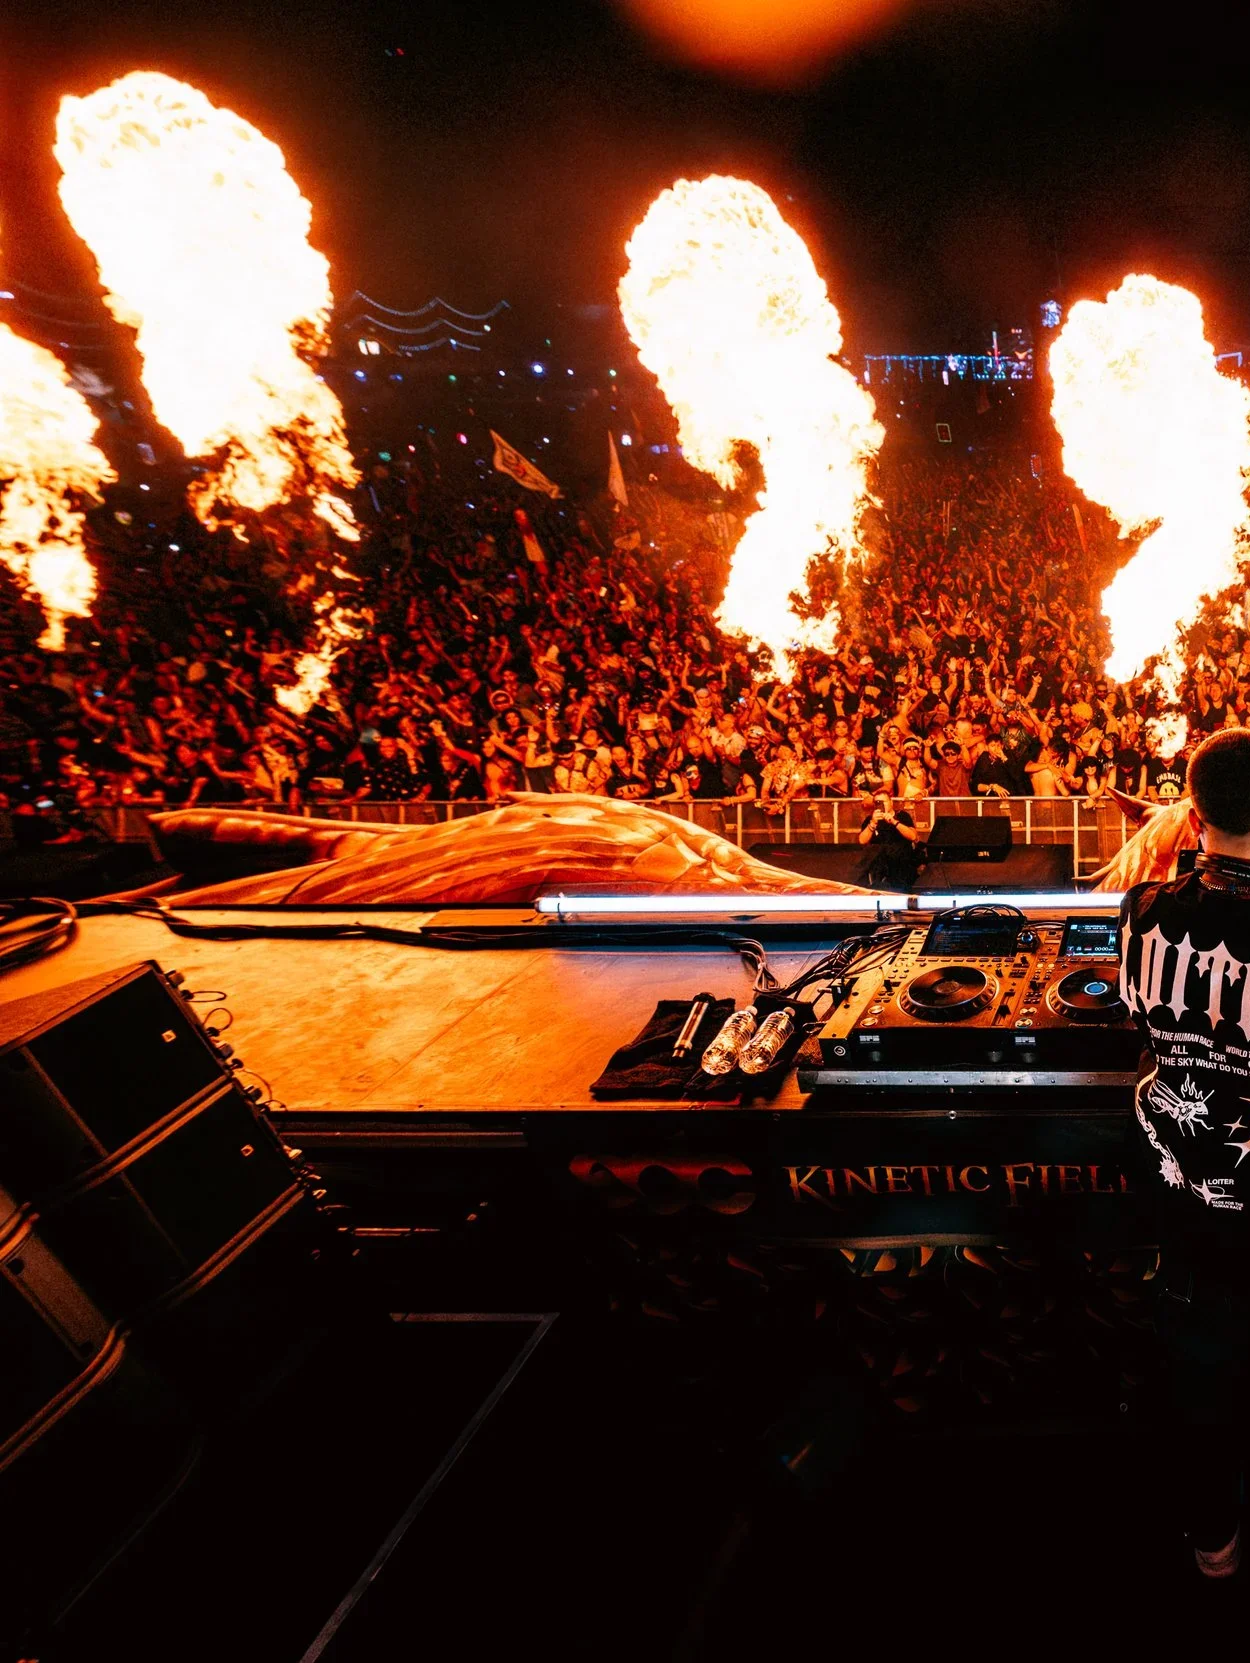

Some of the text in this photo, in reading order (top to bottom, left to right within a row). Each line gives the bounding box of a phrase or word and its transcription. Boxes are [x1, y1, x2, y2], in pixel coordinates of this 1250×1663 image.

[1161, 1031, 1175, 1041] THE
[1173, 1032, 1200, 1043] HUMAN
[1198, 1035, 1215, 1049] RACE
[1225, 1045, 1248, 1058] WORLD
[1170, 1045, 1188, 1055] ALL
[1209, 1051, 1227, 1063] FOR
[1160, 1056, 1176, 1066] THE
[1177, 1057, 1194, 1067] SKY
[1195, 1058, 1218, 1070] WHAT
[1219, 1064, 1231, 1072] DO
[1232, 1066, 1248, 1076] YOU
[781, 1164, 991, 1210] KINETIC
